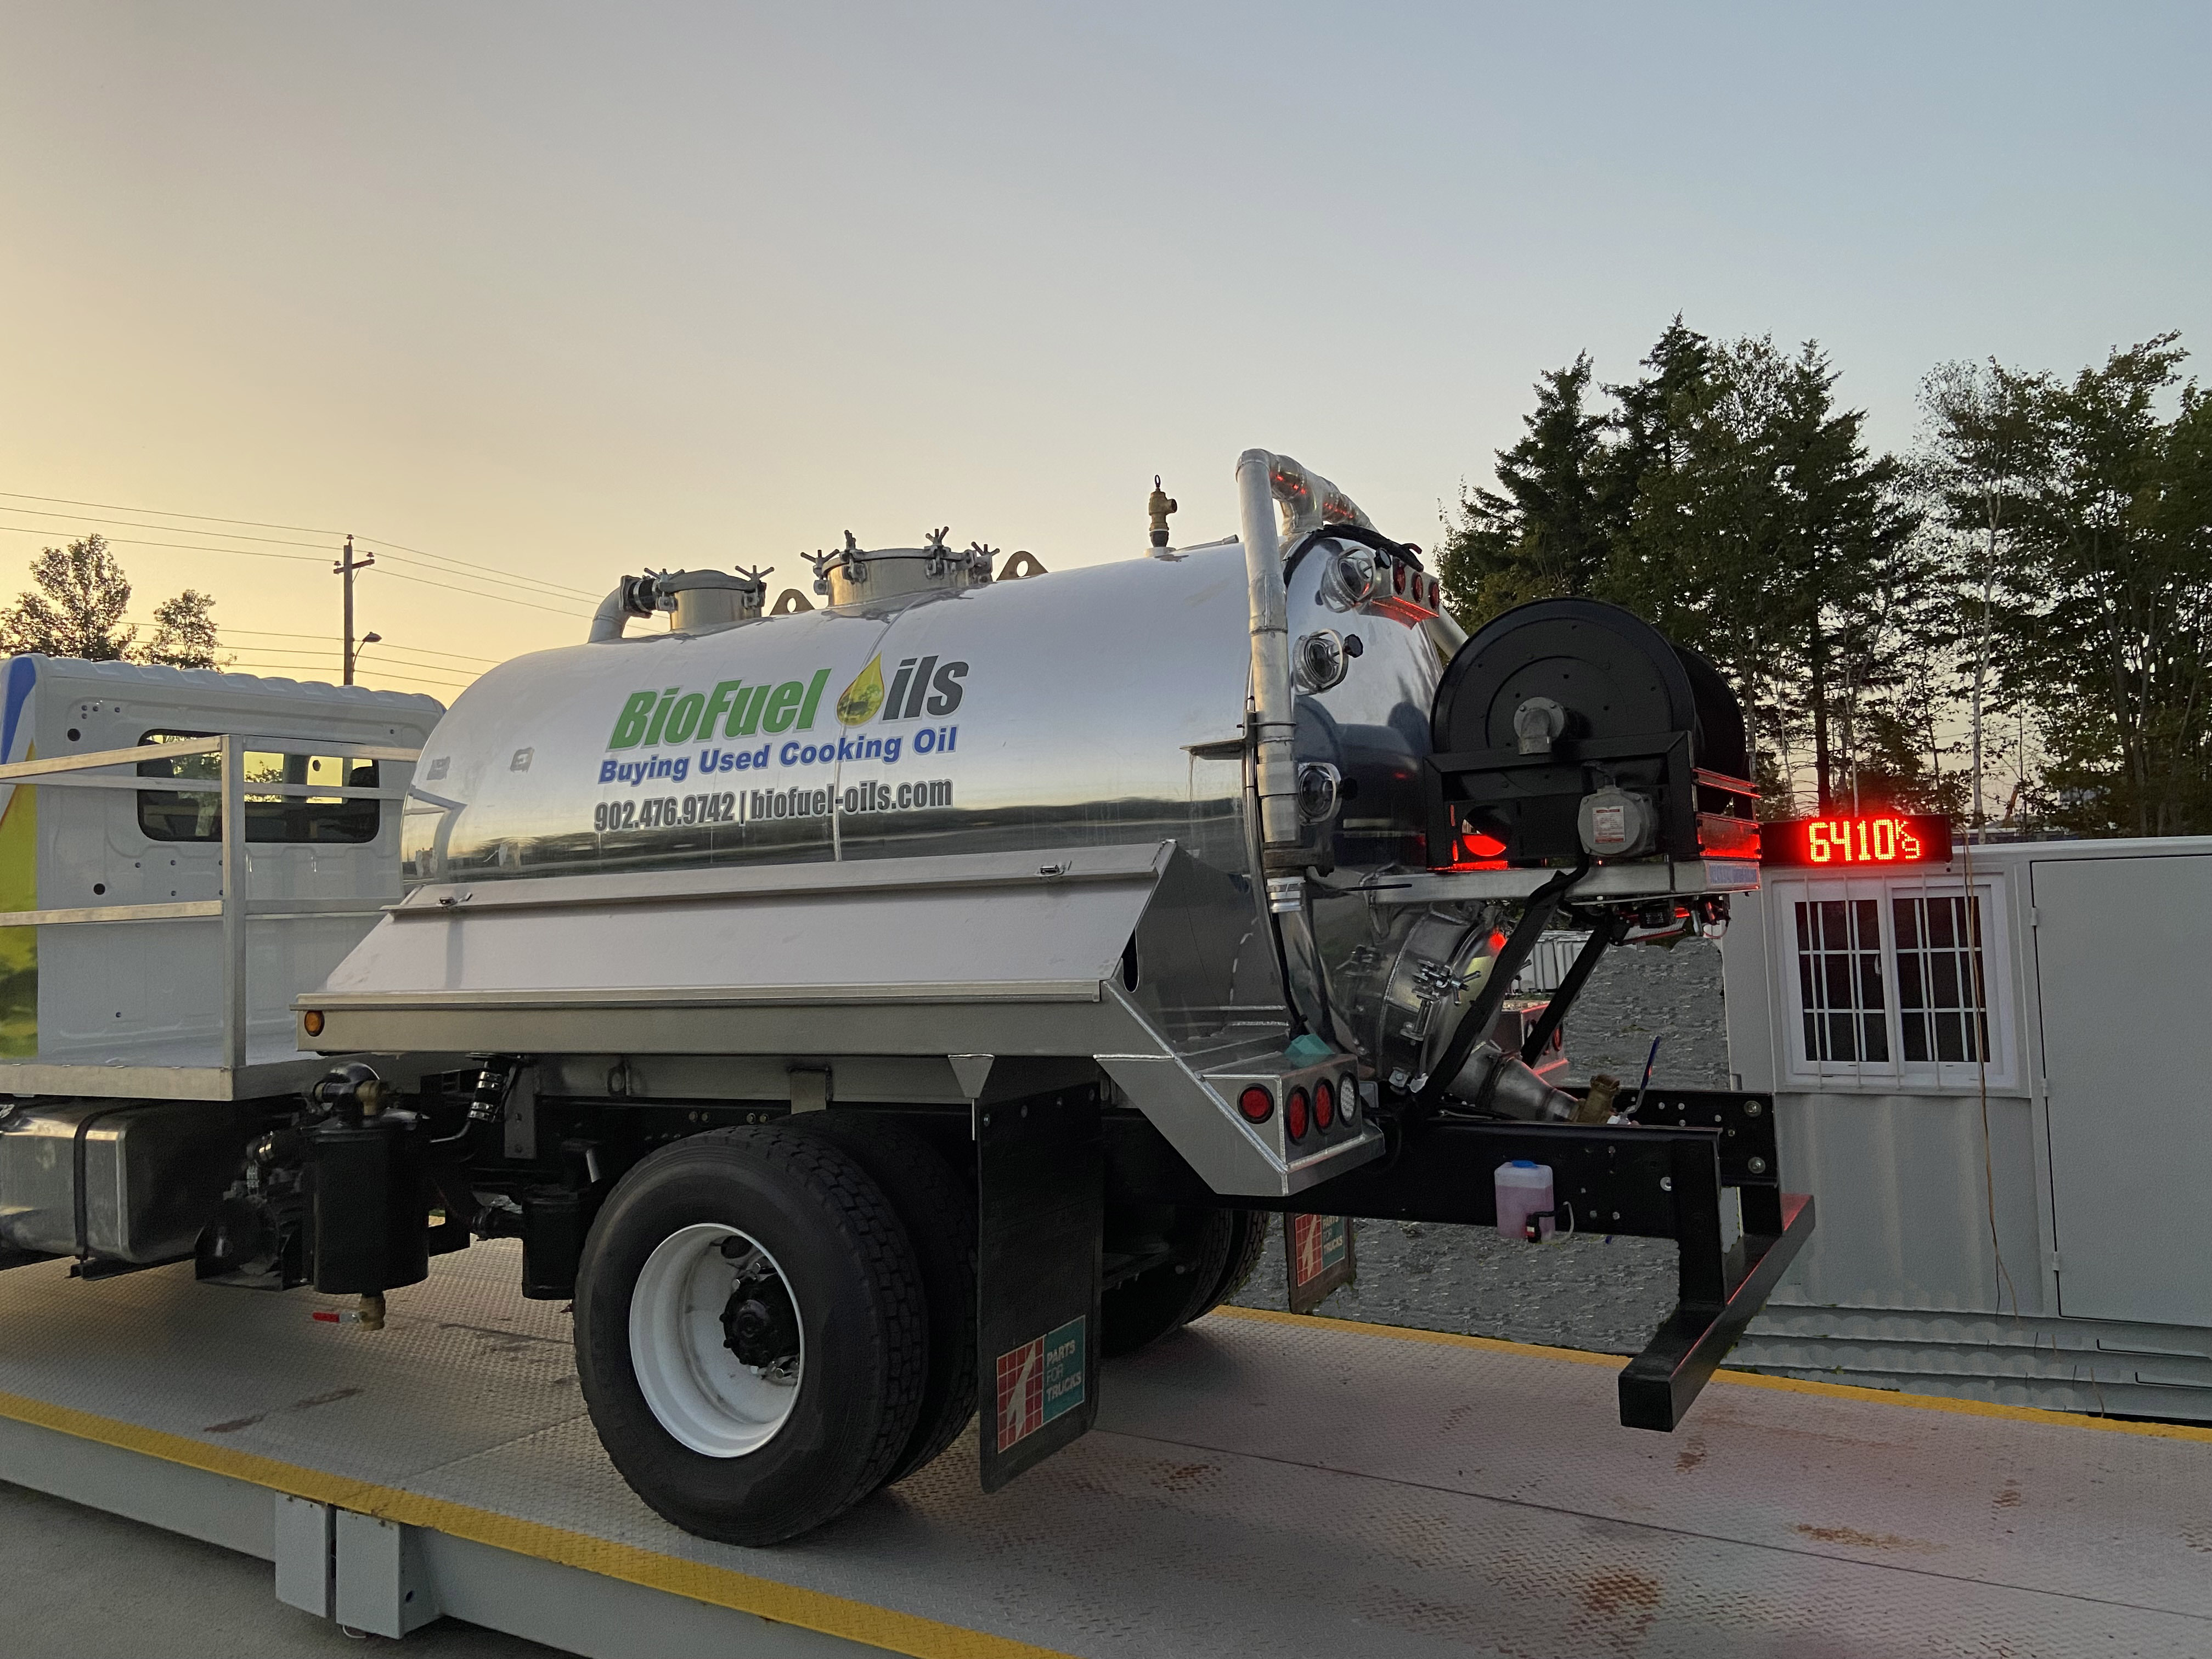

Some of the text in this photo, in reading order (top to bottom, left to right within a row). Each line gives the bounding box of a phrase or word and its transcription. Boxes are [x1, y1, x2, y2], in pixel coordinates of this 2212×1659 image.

[607, 668, 832, 750] BioFuel
[600, 726, 957, 785] Buying Used Cooking Oil
[1809, 819, 1896, 862] 6410
[1047, 1340, 1076, 1365] PARTS
[1047, 1364, 1063, 1381] FOR
[1047, 1372, 1082, 1402] TRUCKS
